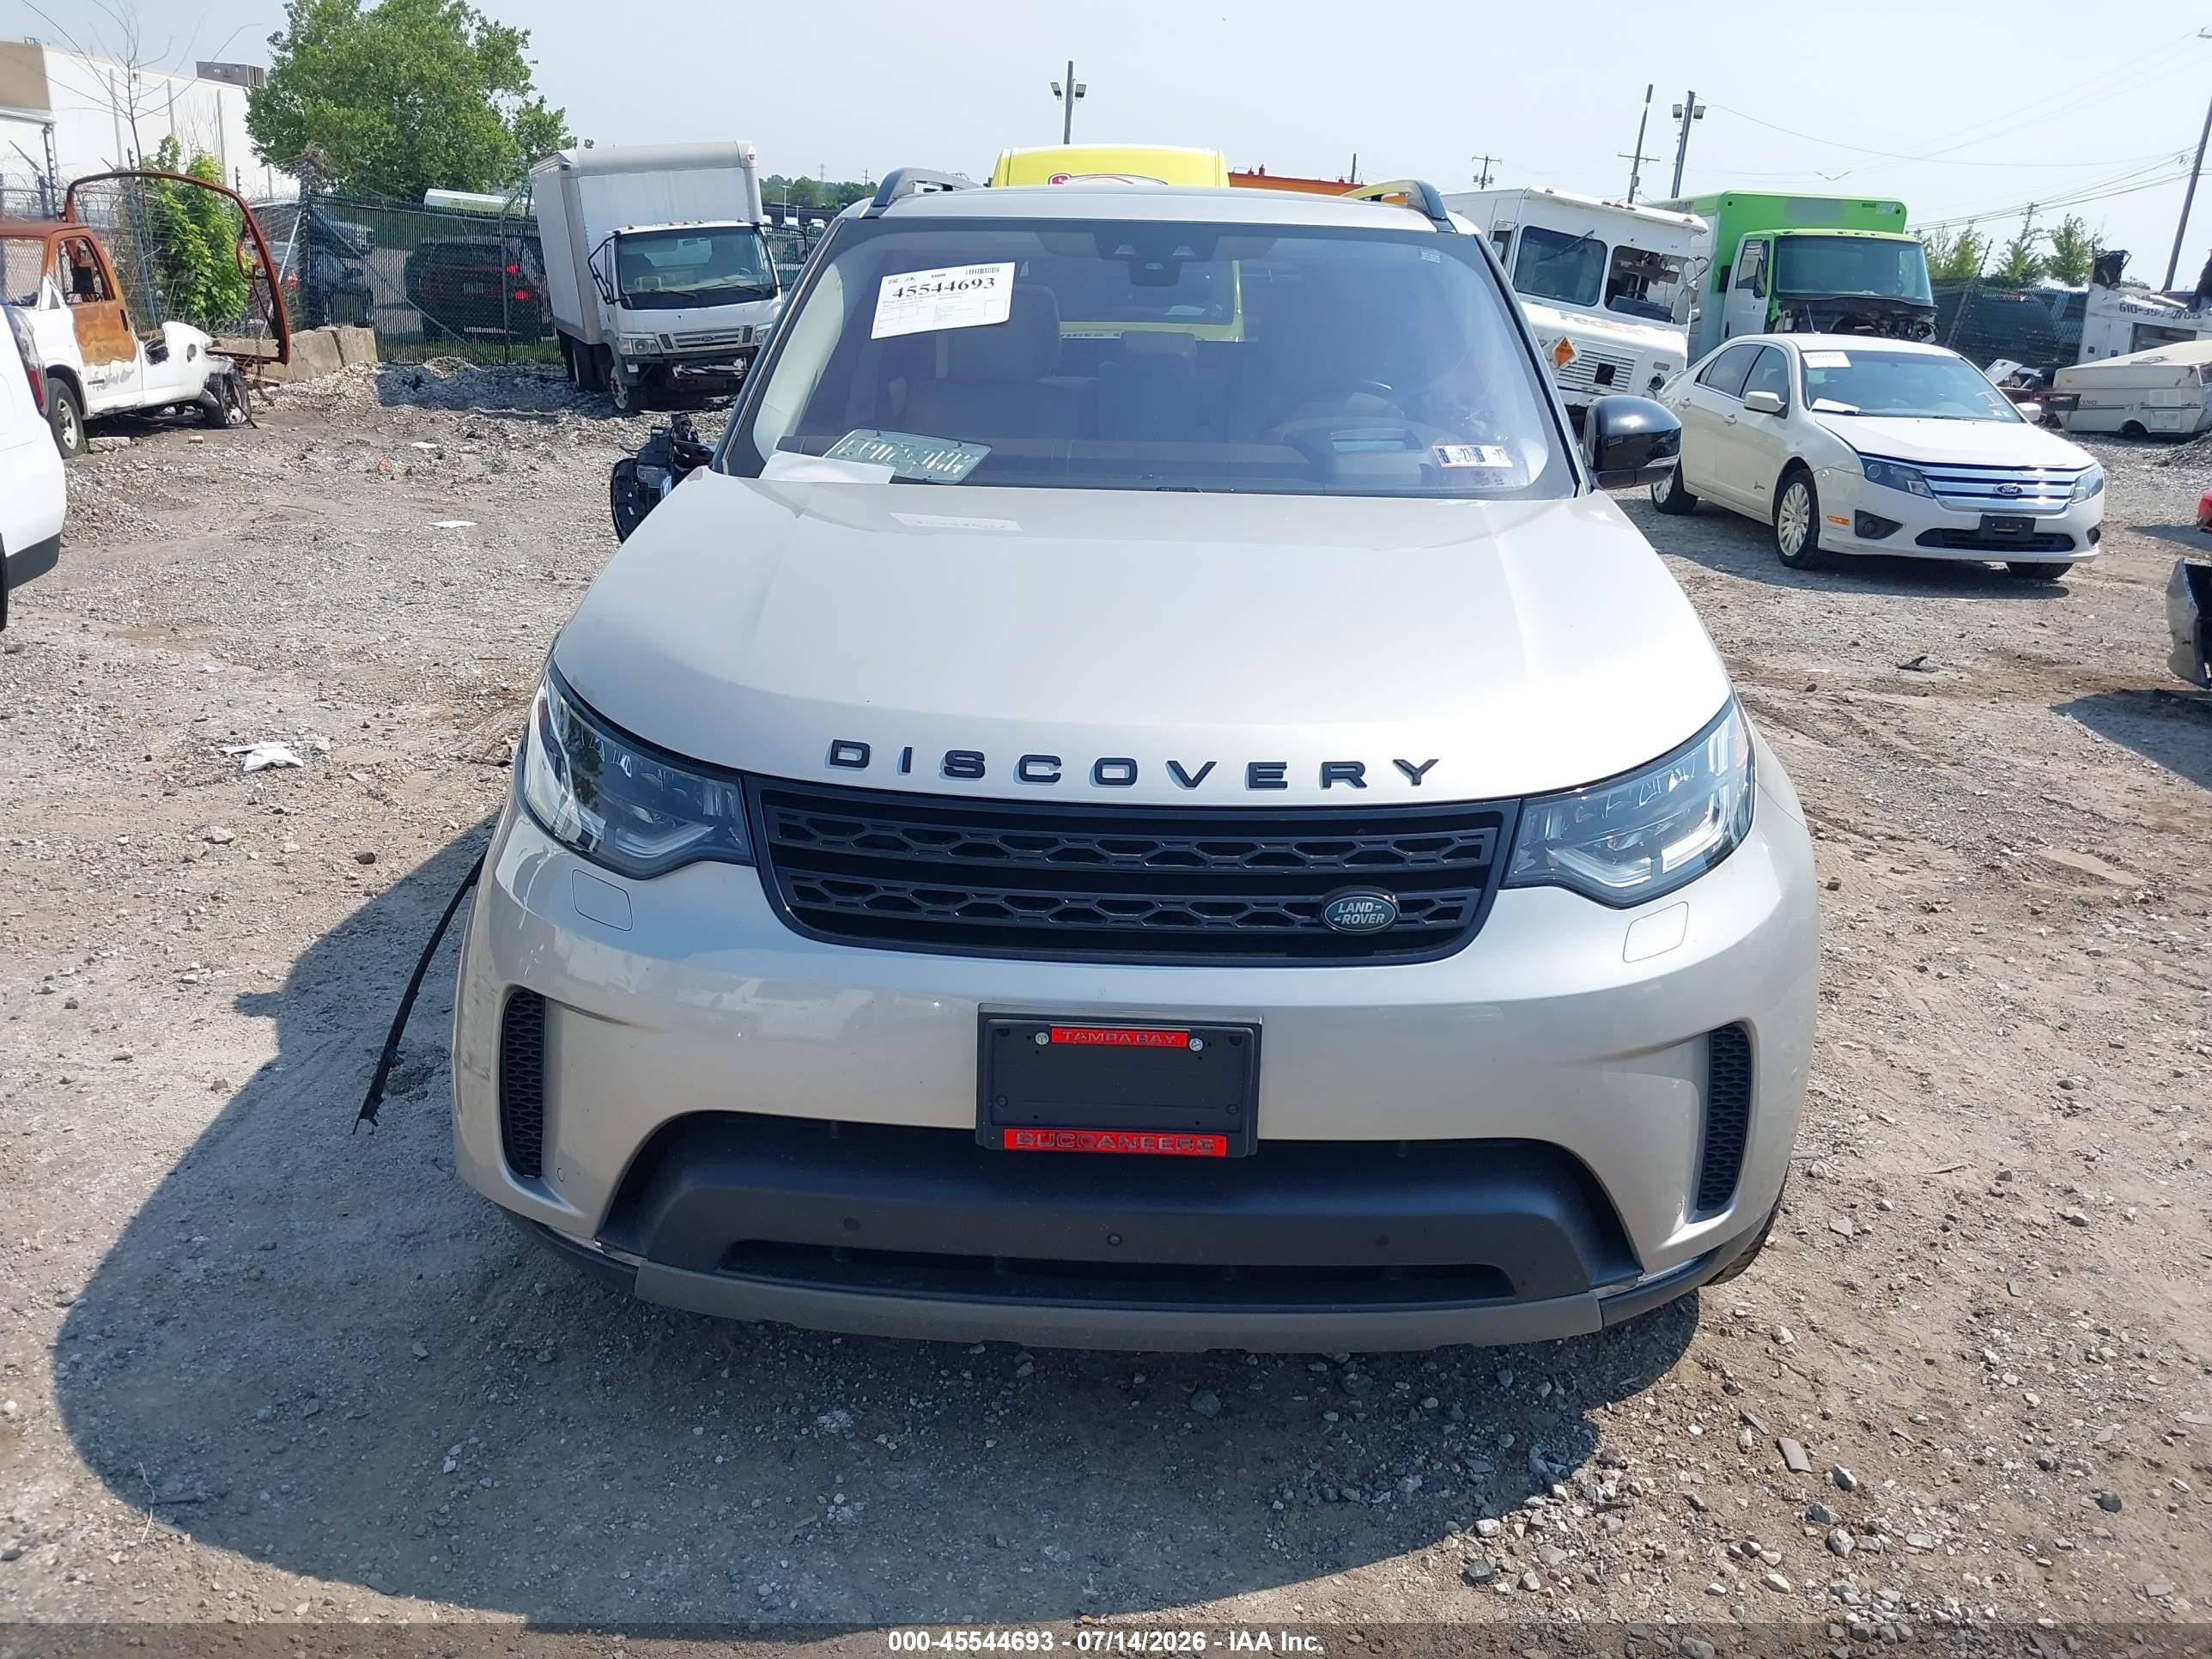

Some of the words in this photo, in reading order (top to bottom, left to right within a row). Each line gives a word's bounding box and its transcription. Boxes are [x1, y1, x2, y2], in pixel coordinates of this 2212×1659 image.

[892, 277, 995, 298] 45544693
[830, 738, 1440, 788] DISCOVERY
[1062, 1030, 1131, 1043] TAMPA
[1135, 1034, 1177, 1044] BAY
[1015, 1132, 1215, 1152] BUCCANEERS
